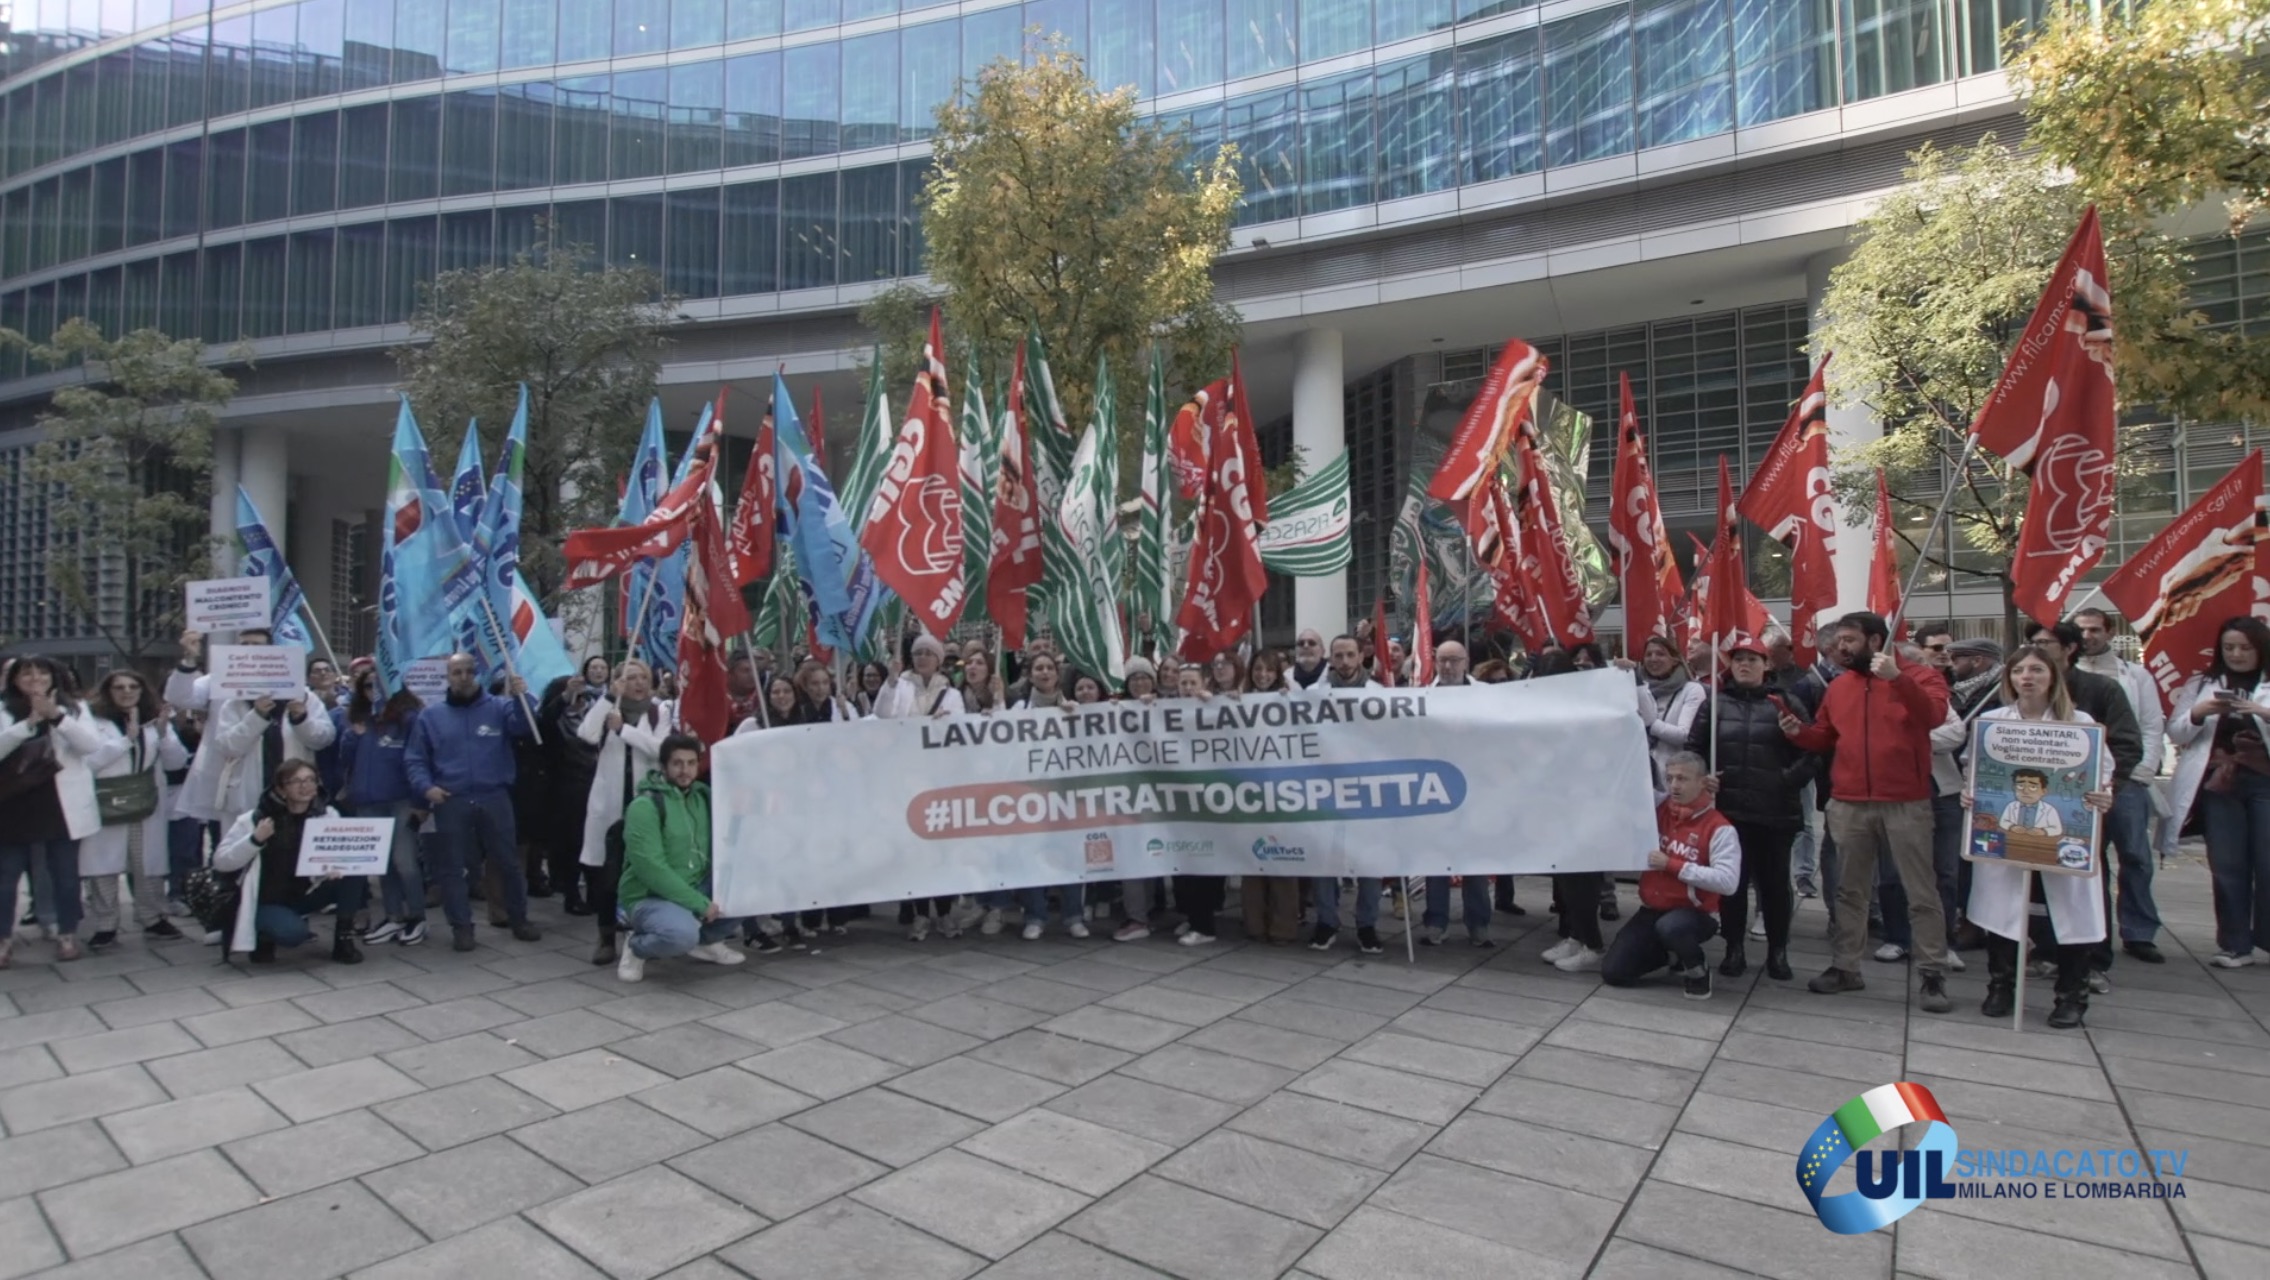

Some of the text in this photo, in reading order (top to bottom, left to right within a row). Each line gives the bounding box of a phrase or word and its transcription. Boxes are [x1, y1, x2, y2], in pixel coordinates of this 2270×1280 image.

[921, 696, 1428, 749] LAVORATRICI E LAVORATORI
[1996, 726, 2080, 740] Siamo SANITARI,
[2001, 736, 2070, 747] non volontari.
[1027, 732, 1321, 773] FARMACIE PRIVATE
[1992, 743, 2036, 754] Vogliamo
[2045, 748, 2082, 758] rinnovo
[2021, 754, 2068, 765] contratto.
[924, 772, 1451, 833] #ILCONTRATTOCISPETTA
[312, 835, 382, 843] RETRIBUZIONI
[314, 844, 377, 852] INADEGUATE
